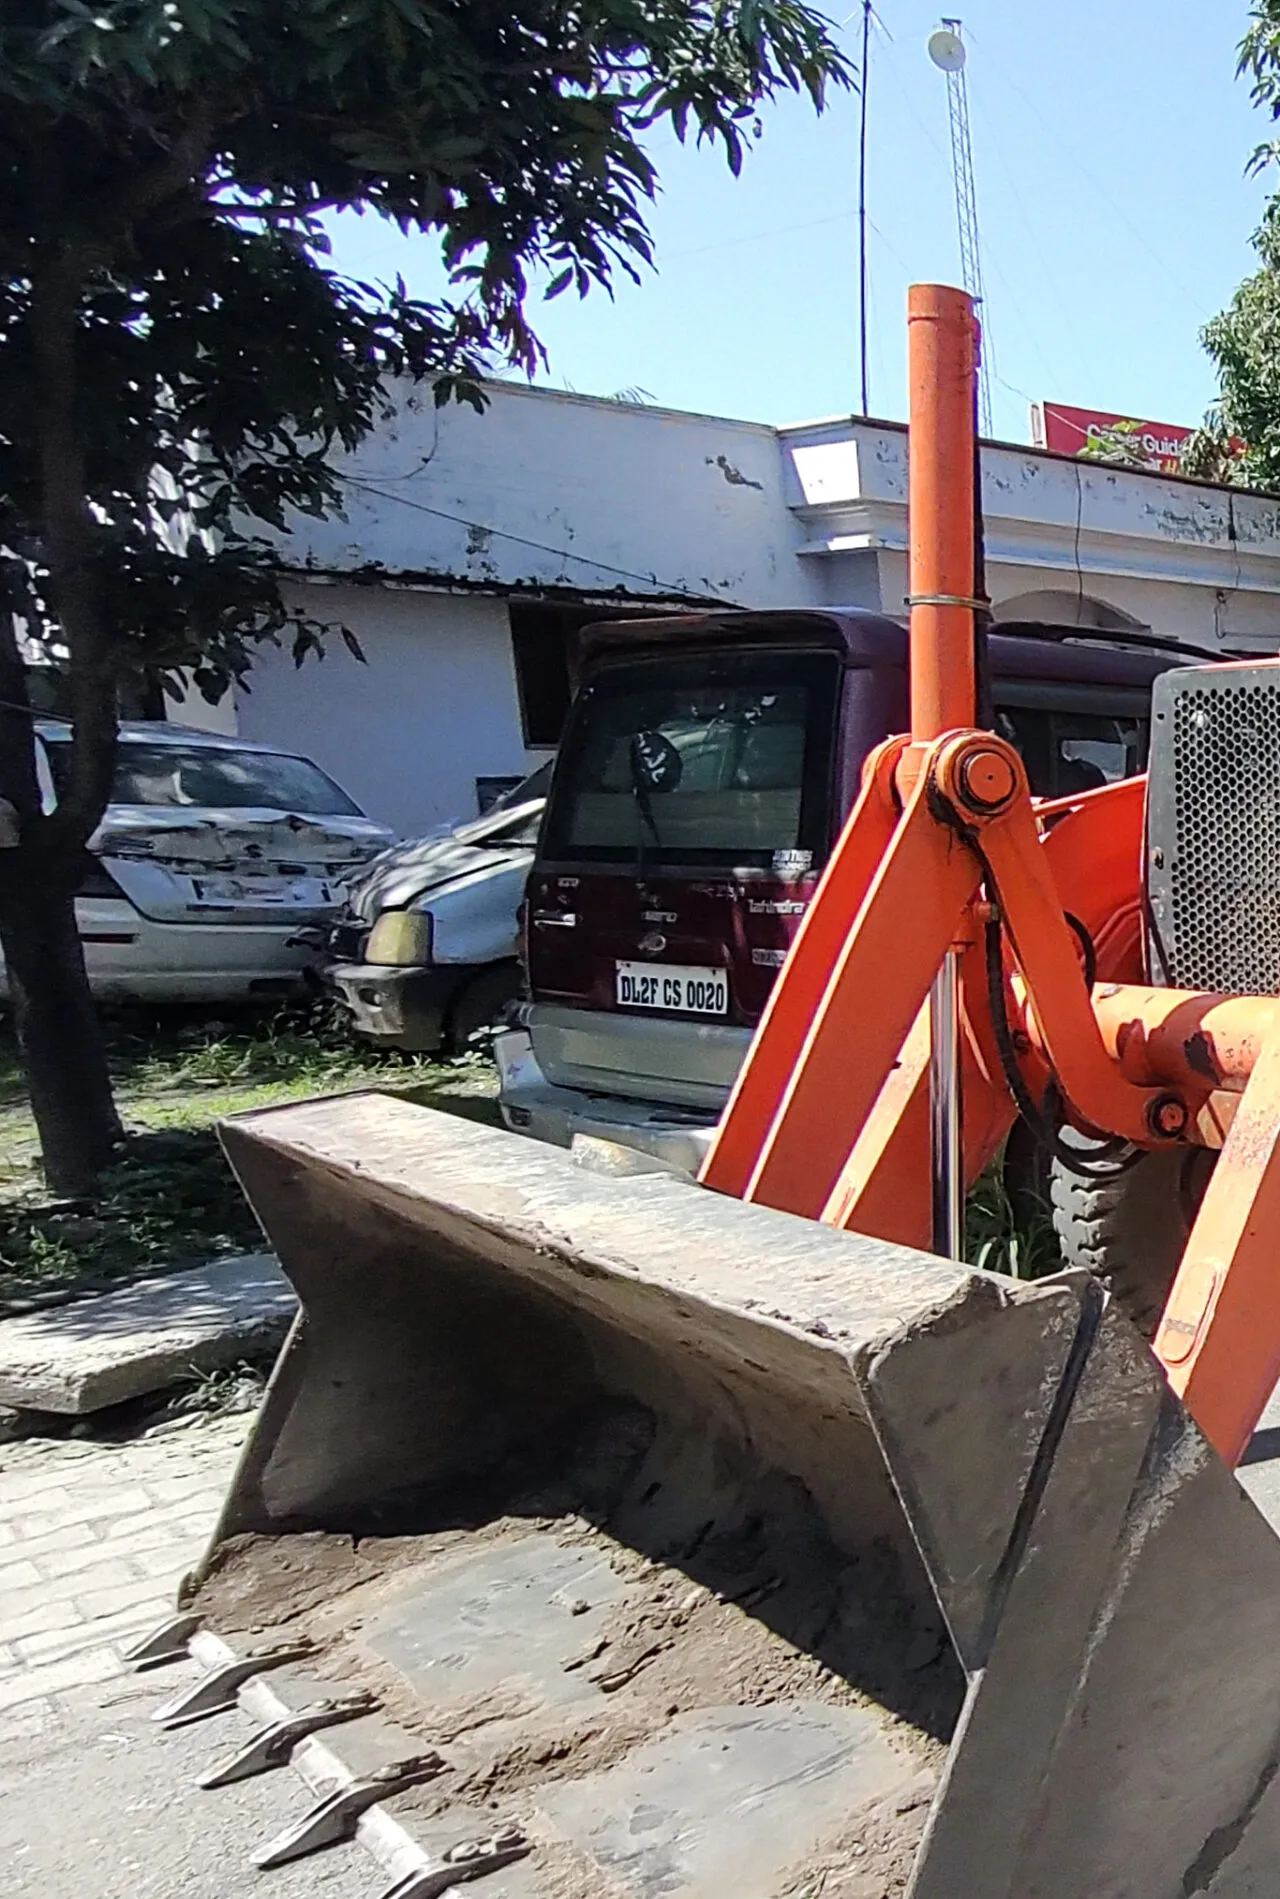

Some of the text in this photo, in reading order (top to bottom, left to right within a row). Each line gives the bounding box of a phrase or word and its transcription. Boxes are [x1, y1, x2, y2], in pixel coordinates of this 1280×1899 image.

[1087, 423, 1182, 456] Caer Guid
[621, 975, 725, 1011] DL2F CS 0020
